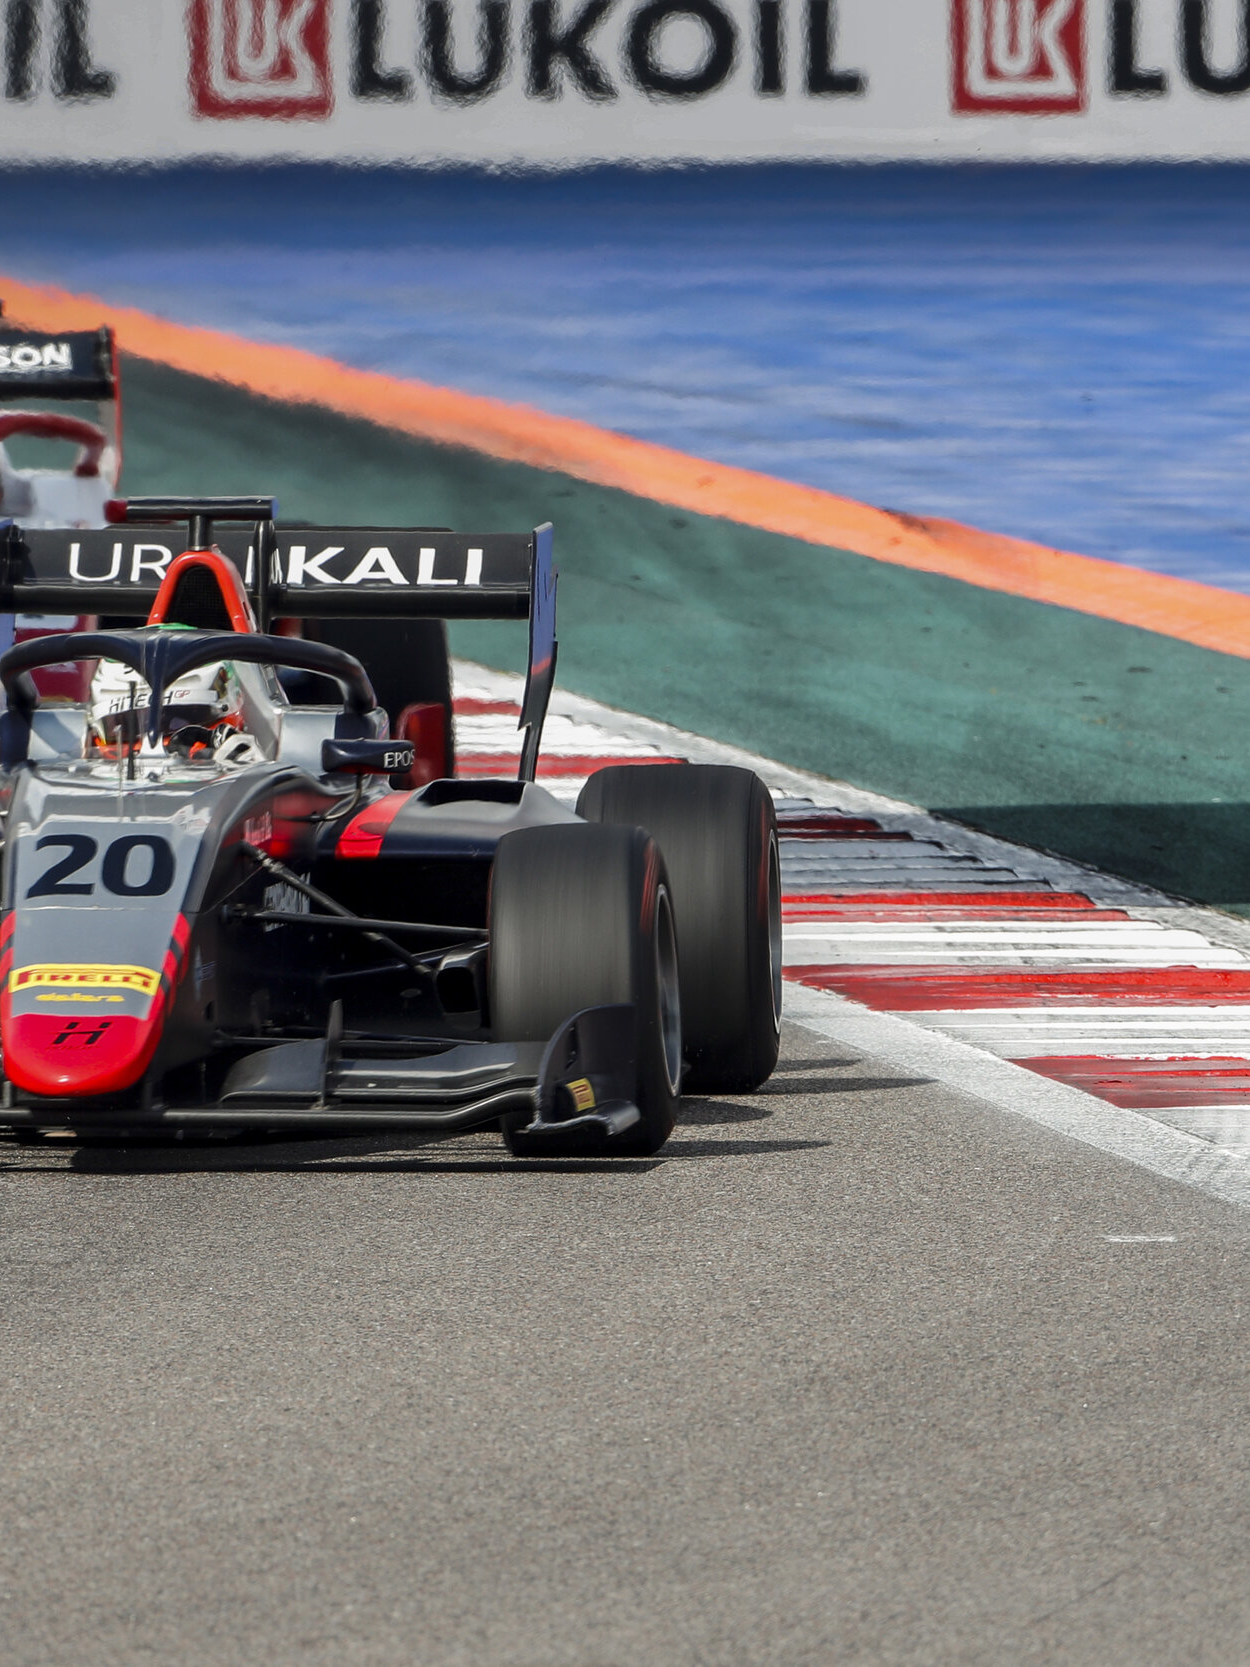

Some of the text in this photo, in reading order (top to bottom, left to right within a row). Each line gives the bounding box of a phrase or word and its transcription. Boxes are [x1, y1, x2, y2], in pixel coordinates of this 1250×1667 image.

[350, 0, 869, 102] LUKOIL
[26, 833, 176, 899] 20
[16, 968, 154, 988] PIRELLI
